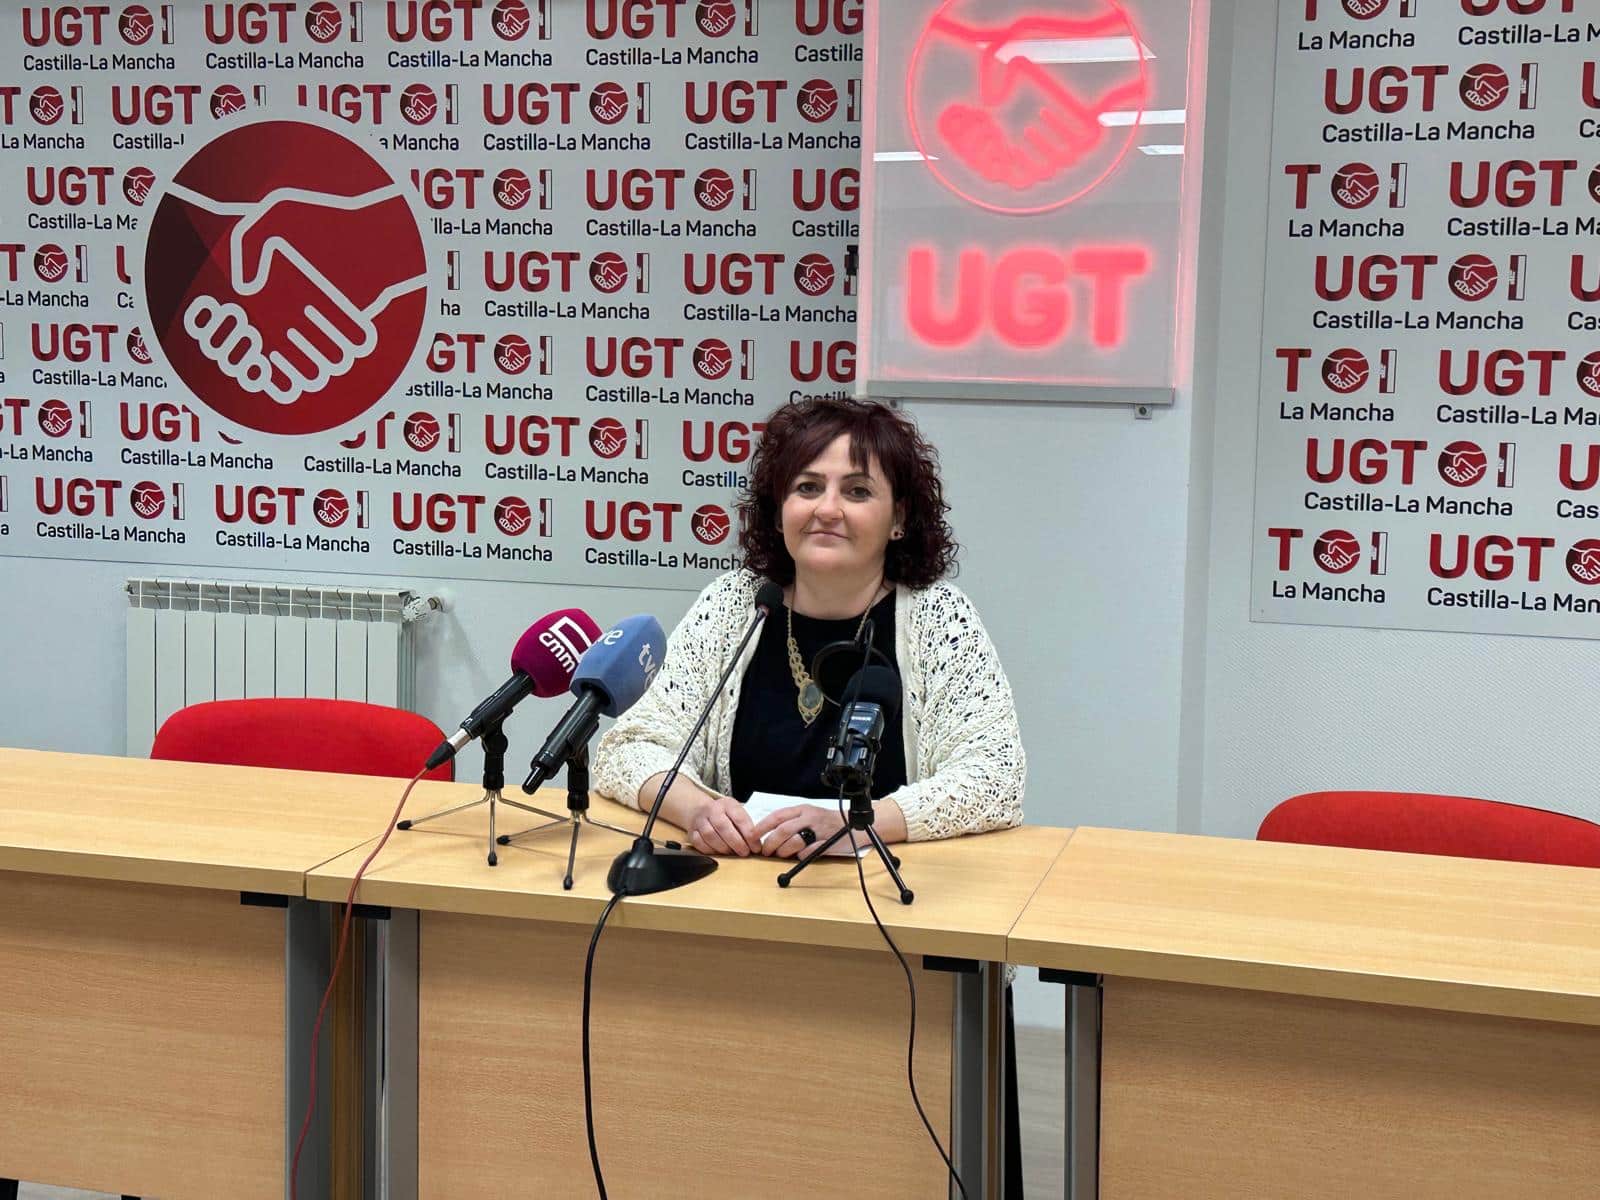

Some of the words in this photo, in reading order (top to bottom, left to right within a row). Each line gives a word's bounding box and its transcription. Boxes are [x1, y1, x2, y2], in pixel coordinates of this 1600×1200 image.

[22, 5, 109, 46] UGT
[204, 2, 295, 44] UGT
[386, 0, 482, 42] UGT
[585, 0, 686, 39] UGT
[795, 0, 863, 36] UG
[1298, 31, 1323, 51] La
[1329, 28, 1415, 50] Mancha
[1458, 23, 1581, 46] Castilla-La
[23, 53, 108, 71] Castilla-La
[112, 52, 176, 70] Mancha
[205, 51, 294, 70] Castilla-La
[298, 50, 364, 69] Mancha
[387, 49, 480, 68] Castilla-La
[484, 48, 553, 67] Mancha
[585, 47, 682, 66] Castilla-La
[687, 45, 759, 65] Mancha
[795, 44, 863, 62] Castilla
[685, 79, 787, 124] UGT
[1324, 65, 1449, 114] UGT
[0, 87, 21, 125] T
[111, 85, 201, 125] UGT
[483, 82, 580, 125] UGT
[1, 133, 20, 150] La
[23, 132, 85, 150] Mancha
[392, 132, 460, 151] Mancha
[483, 132, 577, 151] Castilla-La
[581, 132, 651, 151] Mancha
[685, 131, 783, 151] Castilla-La
[787, 130, 861, 150] Mancha
[1322, 122, 1441, 144] Castilla-La
[1446, 119, 1535, 141] Mancha
[27, 166, 113, 205] UGT
[410, 168, 484, 209] GT
[586, 168, 685, 211] UGT
[792, 168, 859, 211] UG
[1284, 164, 1321, 209] T
[1449, 159, 1578, 208] UGT
[28, 212, 113, 230] Castilla-La
[430, 217, 481, 235] lla-La
[485, 217, 553, 236] Mancha
[586, 218, 681, 237] Castilla-La
[685, 218, 757, 237] Mancha
[1288, 218, 1313, 238] La
[1319, 217, 1405, 238] Mancha
[1447, 216, 1569, 237] Castilla-La
[0, 244, 25, 282] T
[484, 251, 580, 293] UGT
[683, 253, 785, 295] UGT
[1314, 254, 1438, 301] UGT
[27, 290, 89, 308] Mancha
[440, 298, 461, 316] ha
[484, 300, 577, 319] Castilla-La
[581, 301, 650, 320] Mancha
[905, 246, 1151, 350] UGT
[683, 303, 781, 322] Castilla-La
[785, 304, 857, 323] Mancha
[1312, 309, 1430, 330] Castilla-La
[1435, 310, 1524, 330] Mancha
[1567, 311, 1600, 330] Ca
[31, 323, 118, 362] UGT
[426, 332, 486, 374] GT
[585, 336, 684, 378] UGT
[790, 340, 856, 383] UG
[1275, 347, 1313, 393] T
[32, 368, 117, 387] Castilla-La
[120, 371, 168, 389] Manc
[1438, 349, 1567, 396] UGT
[486, 382, 553, 401] Mancha
[585, 384, 680, 404] Castilla-La
[684, 387, 754, 406] Mancha
[0, 398, 30, 435] T
[1279, 401, 1304, 420] La
[1310, 402, 1395, 422] Mancha
[1436, 404, 1557, 425] Castilla-La
[1562, 406, 1600, 426] Ma
[485, 414, 581, 457] UGT
[0, 444, 28, 460] -La
[32, 444, 93, 463] Mancha
[120, 447, 206, 467] Castilla-La
[210, 451, 274, 470] Mancha
[304, 455, 392, 475] Castilla-La
[396, 459, 462, 478] Mancha
[1306, 437, 1428, 486] UGT
[485, 462, 577, 482] Castilla-La
[581, 466, 649, 485] Mancha
[1558, 443, 1600, 491] U
[35, 476, 122, 517] UGT
[215, 484, 305, 526] UGT
[1304, 491, 1420, 513] Castilla-La
[1426, 495, 1513, 517] Mancha
[392, 491, 486, 534] UGT
[585, 500, 681, 543] UGT
[36, 521, 120, 541] Castilla-La
[124, 525, 186, 544] Mancha
[215, 530, 302, 550] Castilla-La
[306, 534, 370, 553] Mancha
[393, 538, 482, 559] Castilla-La
[486, 542, 553, 562] Mancha
[585, 547, 678, 568] Castilla-La
[1267, 527, 1303, 572] T
[1429, 533, 1556, 582] UGT
[1272, 580, 1297, 599] La
[1302, 581, 1386, 604] Mancha
[1427, 587, 1547, 611] Castilla-La
[538, 632, 577, 674] cmm
